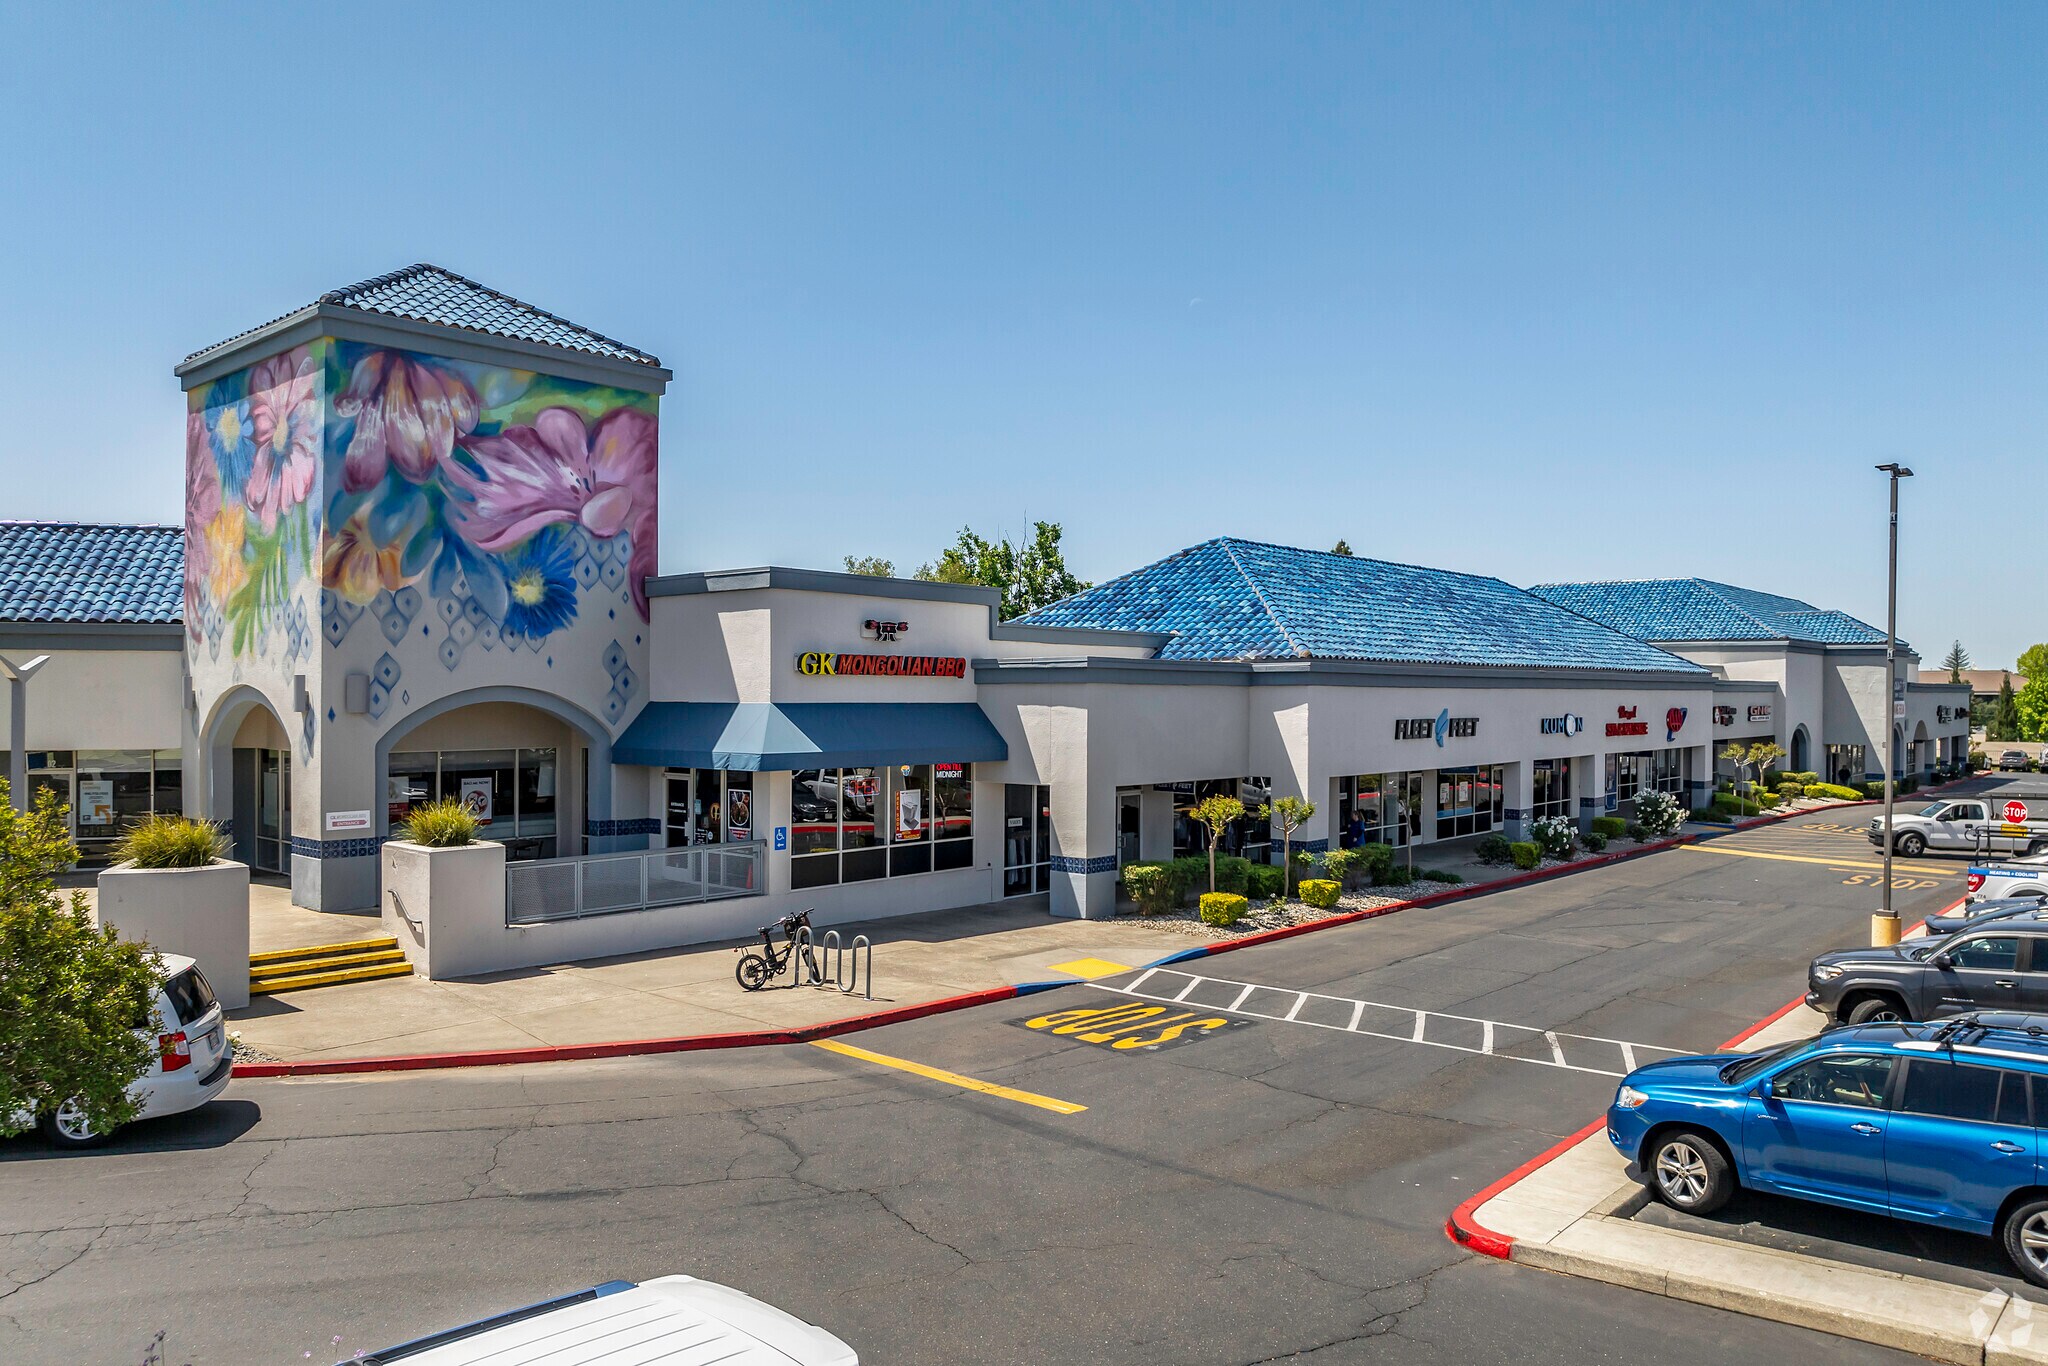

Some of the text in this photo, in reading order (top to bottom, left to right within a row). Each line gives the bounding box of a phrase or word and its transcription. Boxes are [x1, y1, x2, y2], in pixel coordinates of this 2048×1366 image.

[801, 652, 967, 679] GK MONGOLIAN BBQ
[1748, 706, 1772, 716] GNC
[1395, 718, 1479, 740] FLEET FEET
[1541, 713, 1583, 737] KUMON
[936, 770, 963, 778] MIDNIGHT
[952, 763, 963, 771] TILL
[2004, 807, 2026, 818] STOP
[1842, 875, 1940, 891] STOP
[1025, 1002, 1228, 1049] STOP
